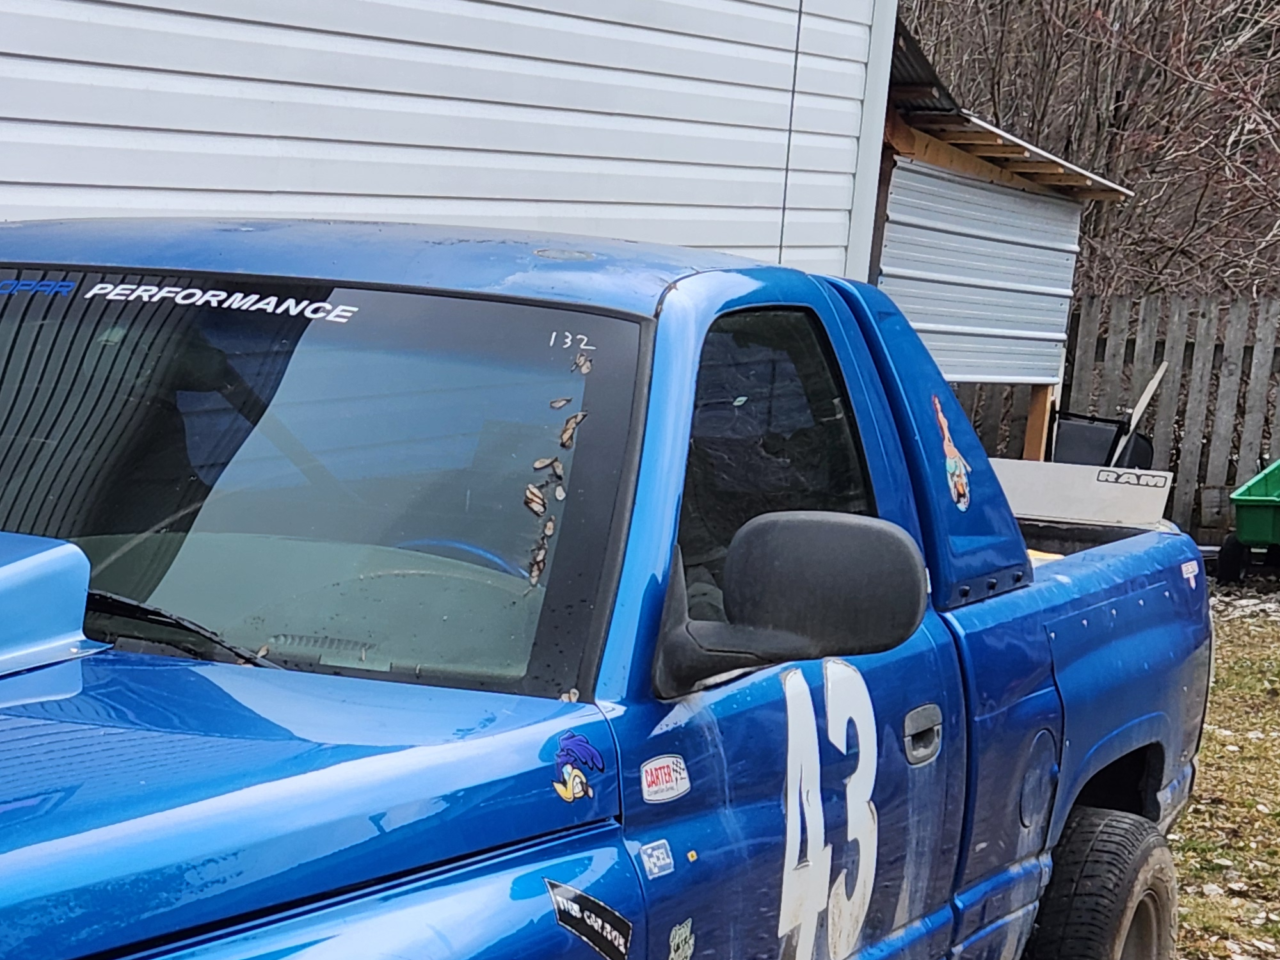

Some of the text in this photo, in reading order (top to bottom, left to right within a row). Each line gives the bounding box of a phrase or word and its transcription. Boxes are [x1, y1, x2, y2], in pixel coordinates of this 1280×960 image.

[84, 282, 359, 323] PERFORMANCE
[549, 331, 597, 350] 132
[1096, 469, 1168, 488] RAM
[644, 764, 674, 789] CARTER
